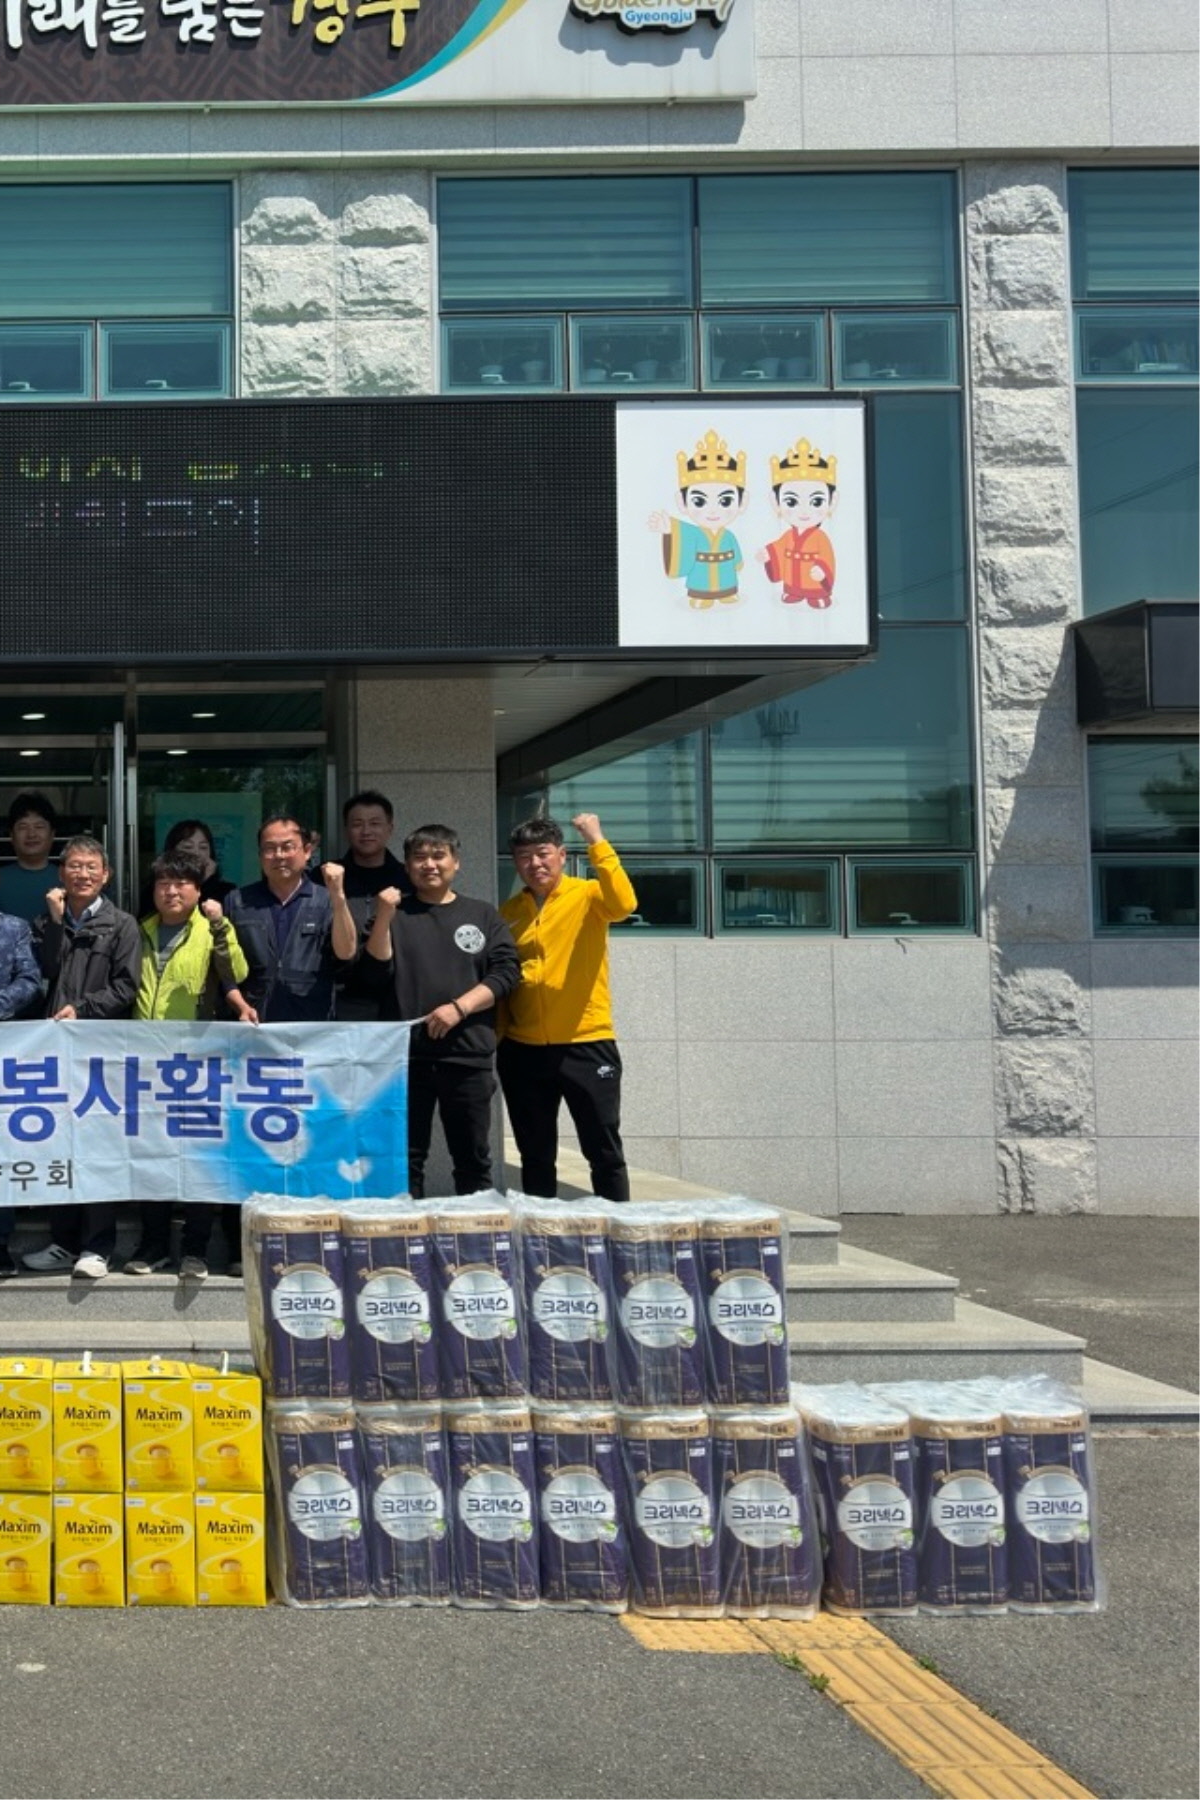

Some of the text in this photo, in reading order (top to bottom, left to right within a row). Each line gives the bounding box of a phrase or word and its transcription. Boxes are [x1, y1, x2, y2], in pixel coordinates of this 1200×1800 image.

[625, 10, 693, 24] Gyeongju
[279, 1297, 336, 1312] 크리넥스
[365, 1301, 422, 1316] 크리넥스
[452, 1297, 509, 1313] 크리넥스
[541, 1299, 599, 1315] 크리넥스
[717, 1302, 776, 1318] 크리넥스
[629, 1305, 687, 1320] 크리넥스
[65, 1404, 111, 1420] Maxim
[136, 1406, 182, 1421] Maxim
[205, 1405, 252, 1419] Maxim
[549, 1499, 607, 1514] 크리넥스
[643, 1504, 704, 1519] 크리넥스
[731, 1504, 792, 1519] 크리넥스
[939, 1503, 998, 1519] 크리넥스
[1025, 1500, 1083, 1515] 크리넥스
[847, 1507, 906, 1523] 크리넥스
[65, 1520, 113, 1535] Maxim
[138, 1519, 184, 1535] Maxim
[207, 1519, 254, 1534] Maxim
